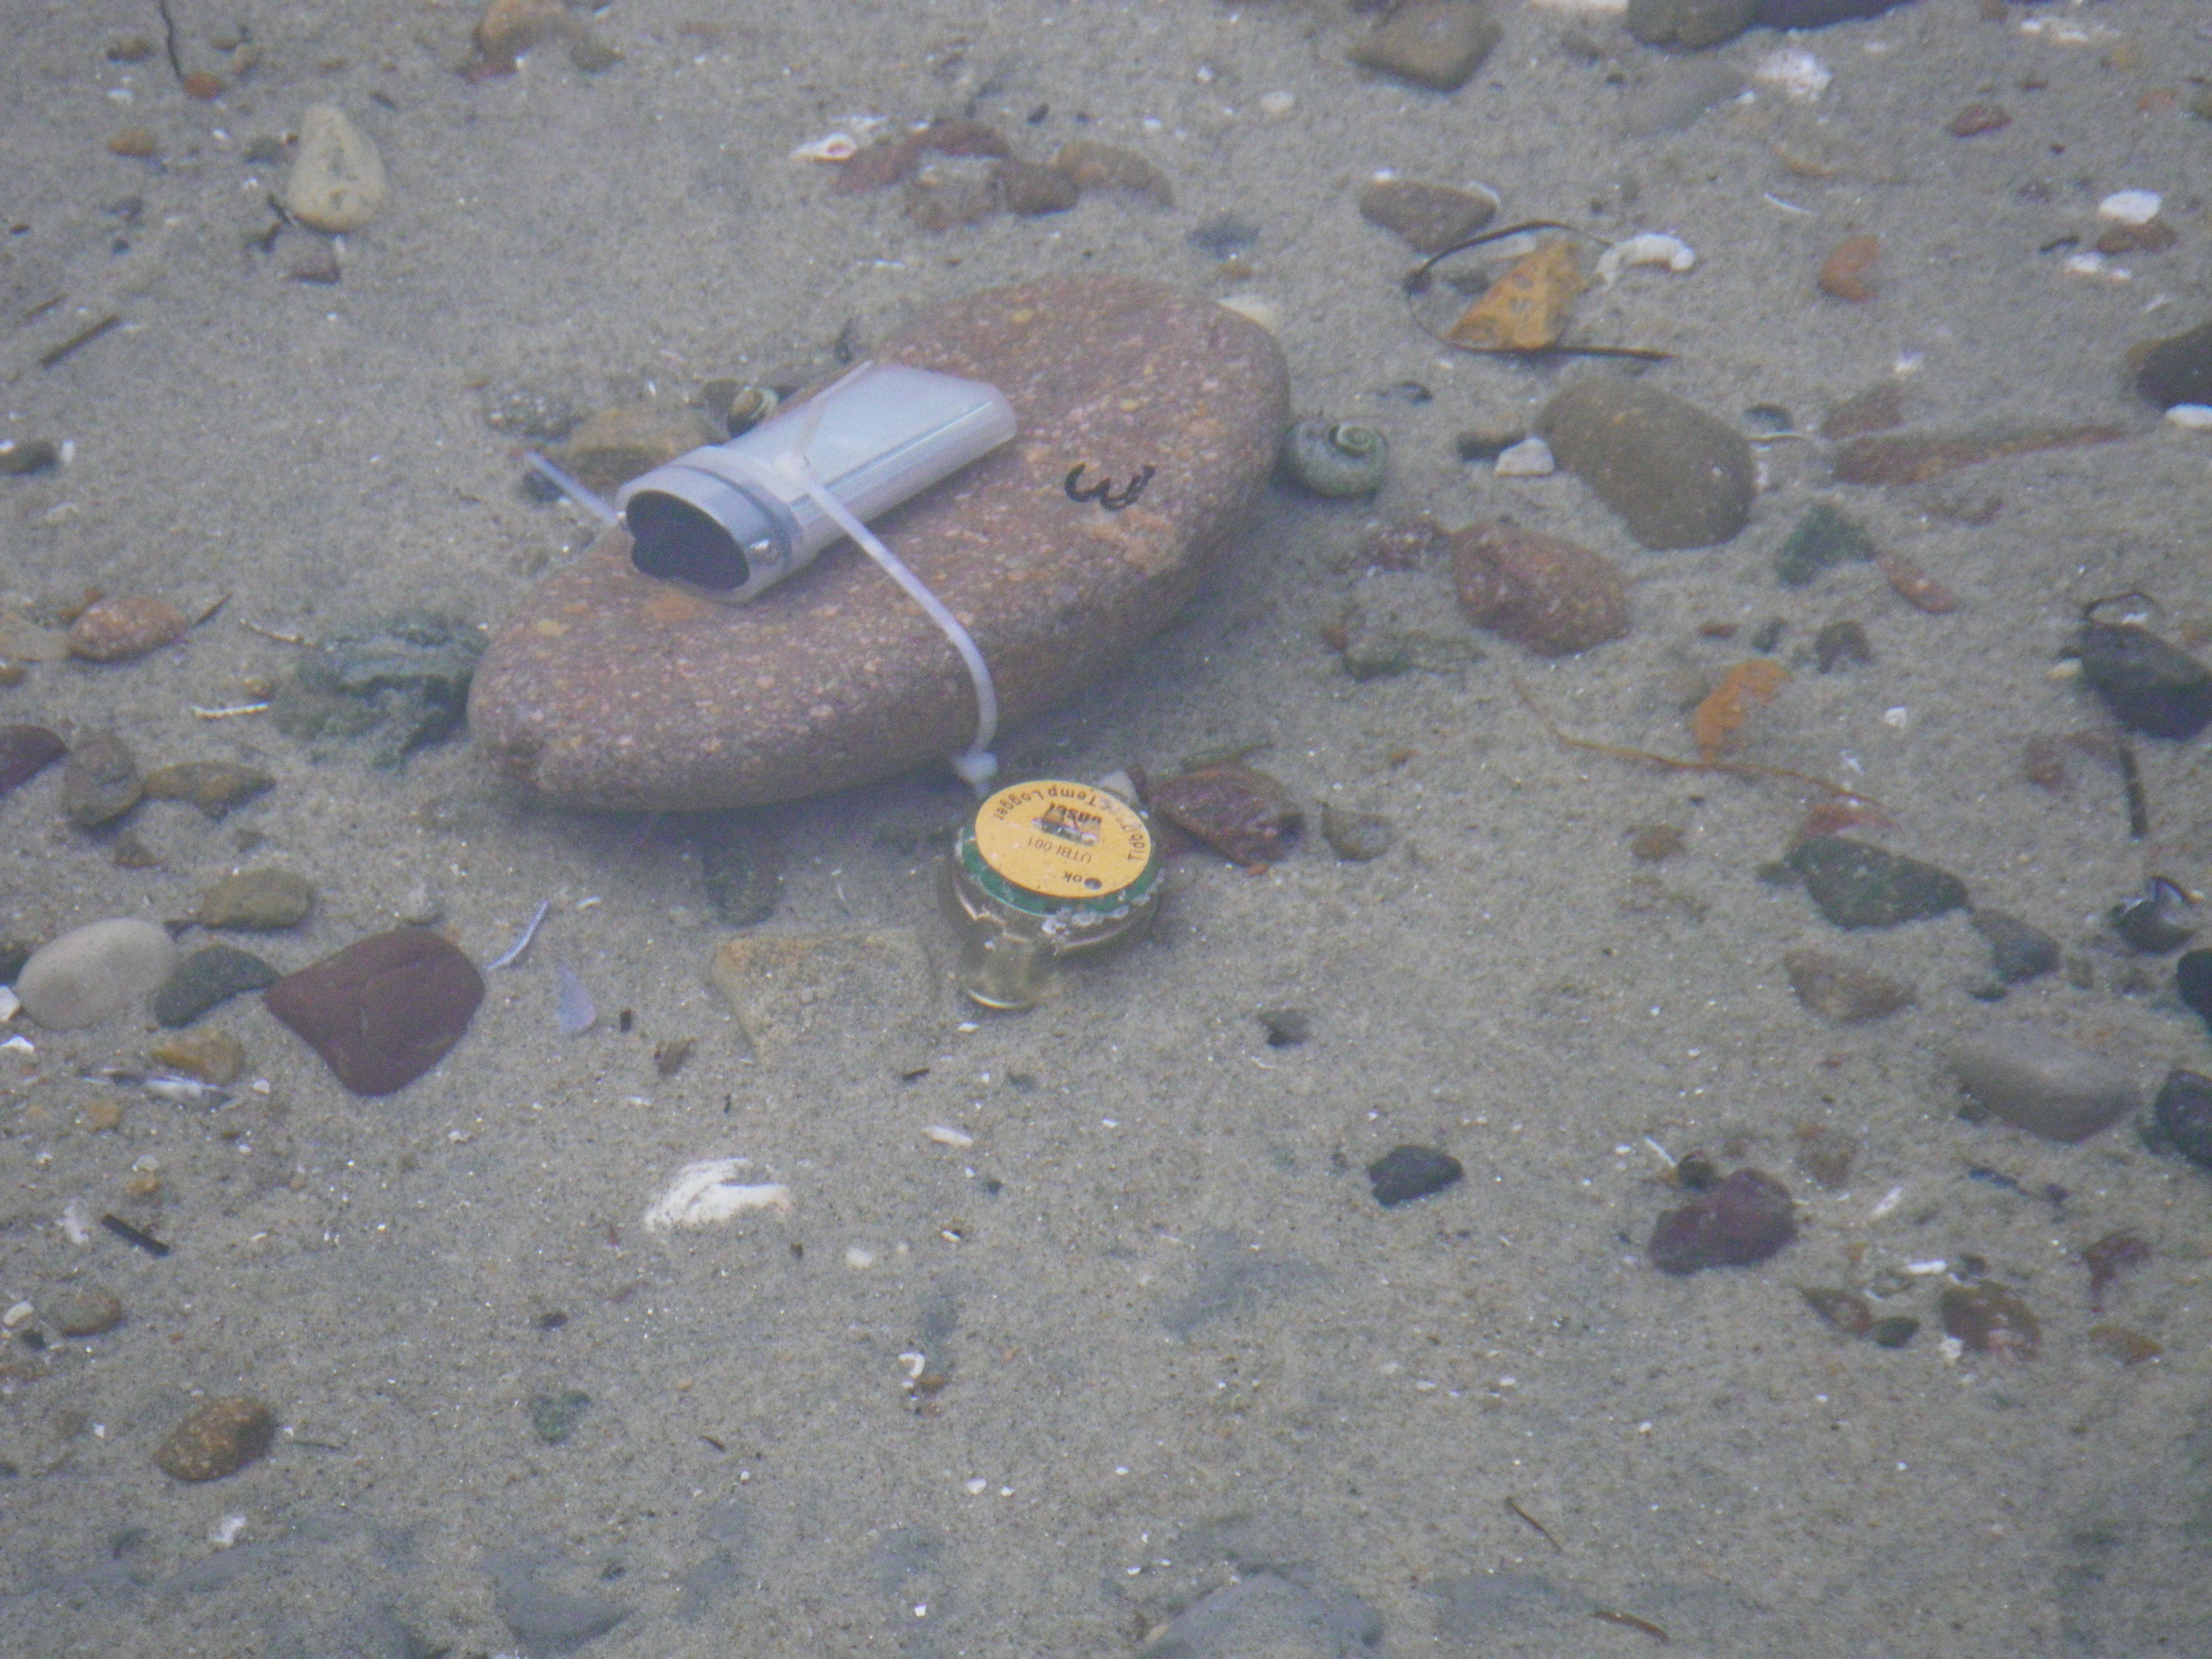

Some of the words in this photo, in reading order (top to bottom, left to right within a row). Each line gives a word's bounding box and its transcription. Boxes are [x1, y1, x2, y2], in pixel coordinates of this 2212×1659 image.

[993, 790, 1045, 821] Logger
[1047, 784, 1100, 806] Temp
[1064, 870, 1083, 883] ok
